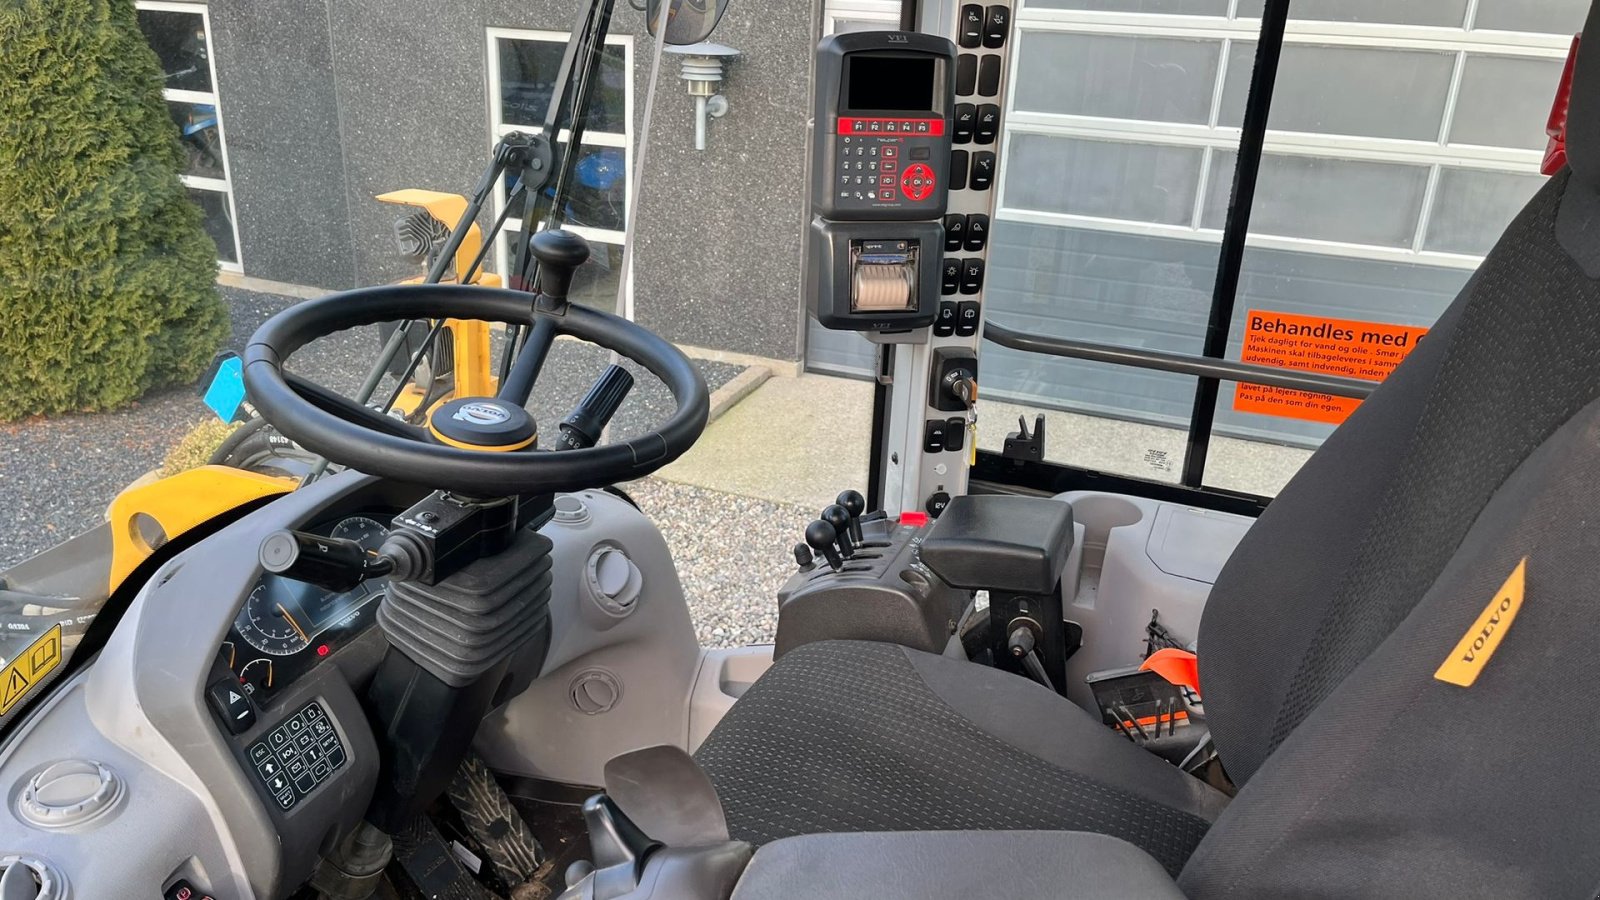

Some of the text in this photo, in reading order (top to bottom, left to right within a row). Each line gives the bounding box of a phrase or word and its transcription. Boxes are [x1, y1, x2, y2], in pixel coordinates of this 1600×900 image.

[1251, 316, 1354, 341] Behandles
[1361, 332, 1408, 346] med
[1247, 345, 1286, 354] Maskinen
[1308, 352, 1366, 364] tilbageleveres
[1250, 334, 1266, 343] Tjek
[1268, 337, 1298, 347] dagligt
[1376, 349, 1399, 357] Smør
[1246, 355, 1286, 366] udvendig,
[1312, 363, 1356, 374] indvendig,
[1300, 391, 1334, 402] regning.
[339, 611, 360, 626] VOLVO
[1462, 597, 1511, 663] VOLVO
[255, 748, 265, 757] ESC
